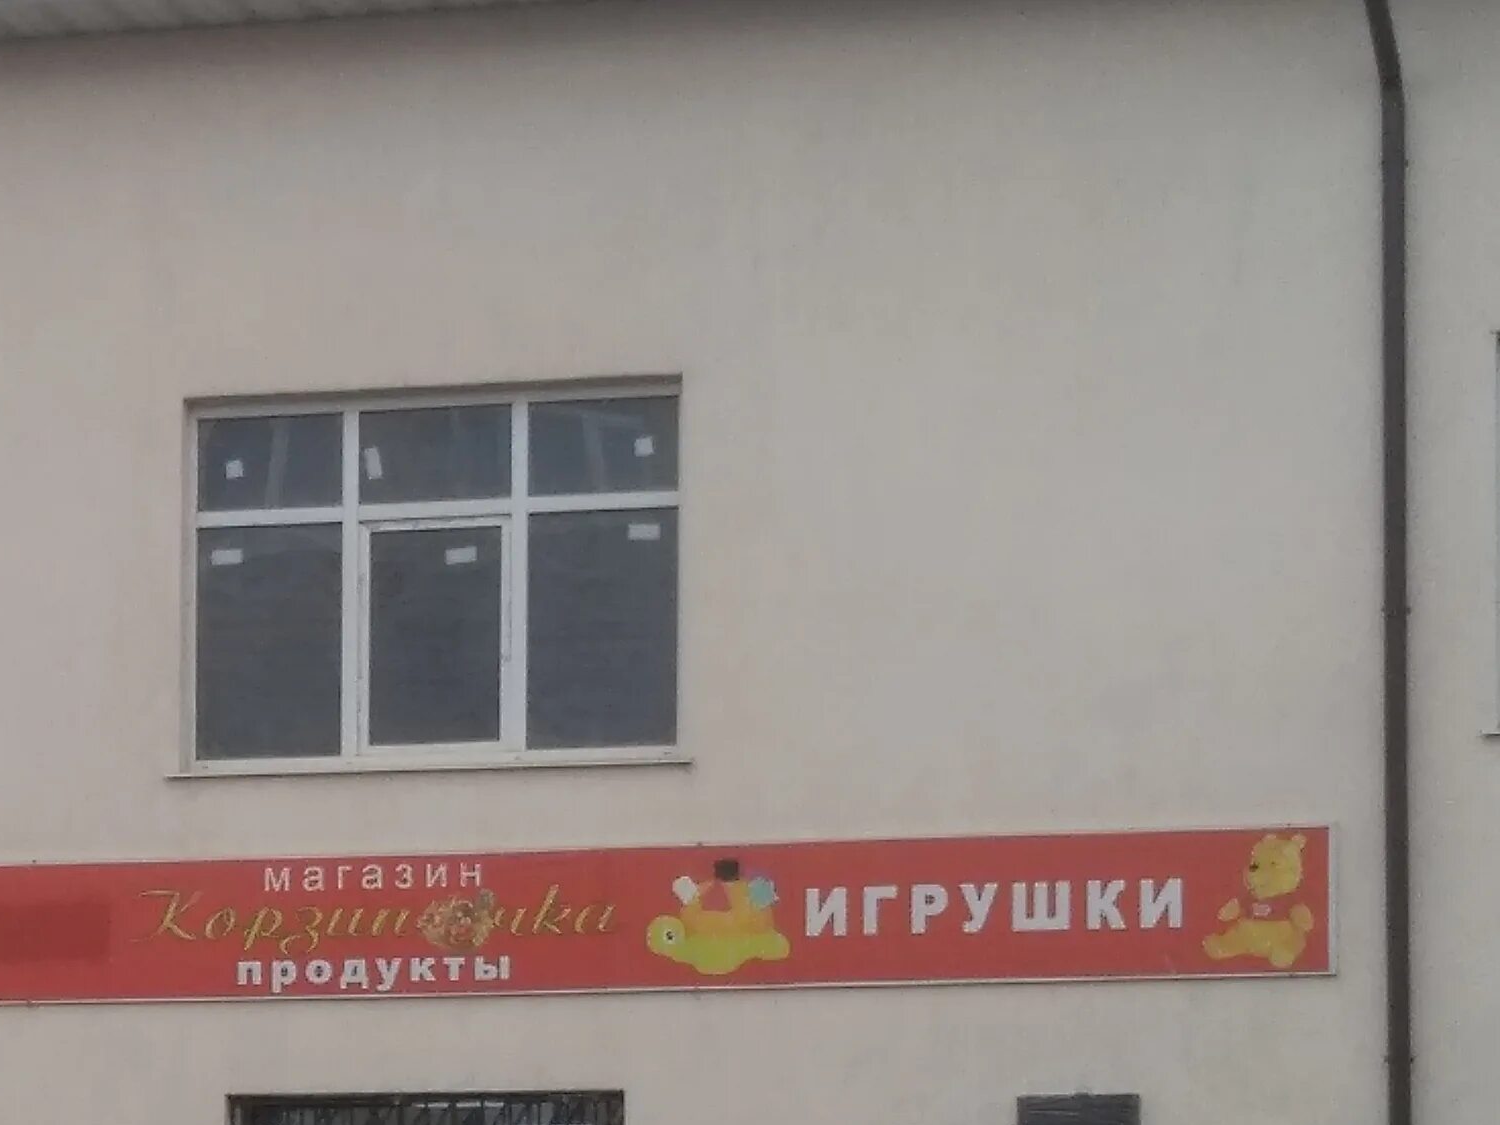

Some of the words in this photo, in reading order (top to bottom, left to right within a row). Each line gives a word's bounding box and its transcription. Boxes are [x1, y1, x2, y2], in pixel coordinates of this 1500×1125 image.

[263, 863, 484, 892] магазин
[805, 878, 1183, 936] ИГРУШКИ
[236, 955, 511, 992] продукты
